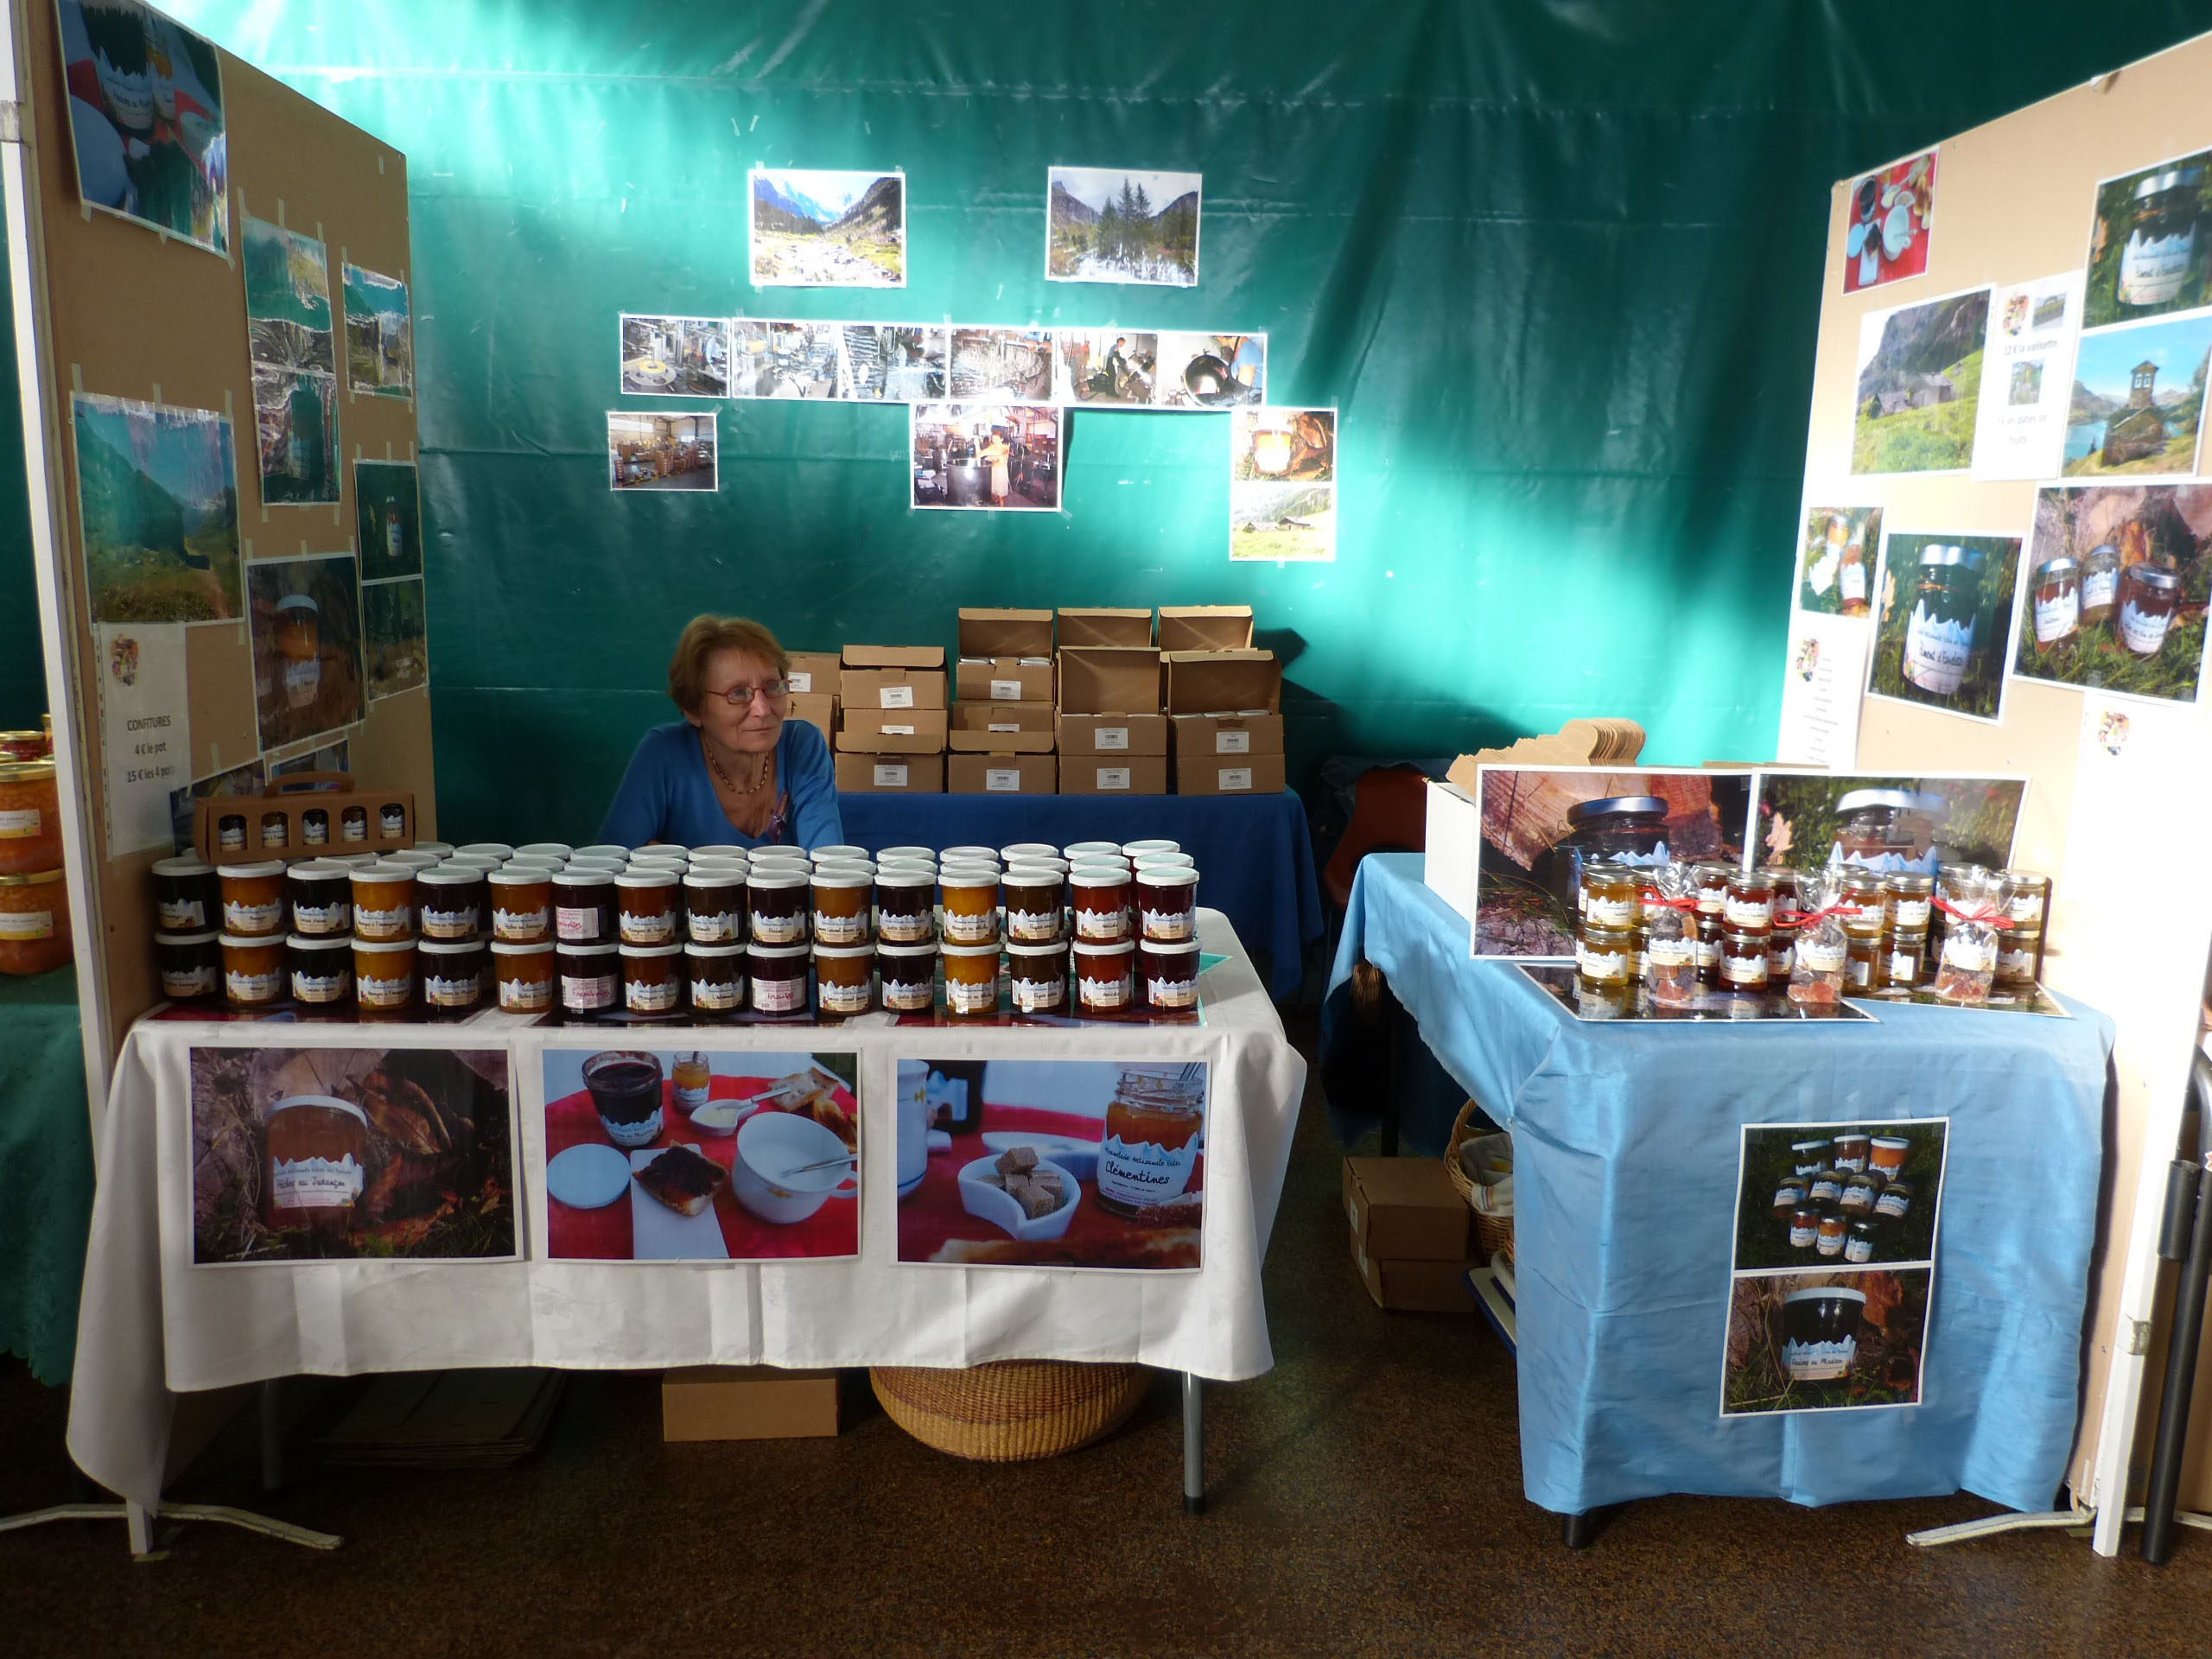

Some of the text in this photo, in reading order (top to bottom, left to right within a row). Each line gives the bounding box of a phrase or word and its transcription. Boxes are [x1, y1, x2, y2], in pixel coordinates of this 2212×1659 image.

[126, 715, 171, 732] CONFITURES
[135, 741, 167, 755] 4 € le pot
[127, 770, 137, 783] 15
[137, 768, 143, 781] €
[144, 768, 154, 780] les
[156, 766, 160, 778] 4
[1105, 1160, 1171, 1185] Clémentines
[312, 1175, 346, 1190] Jurançon
